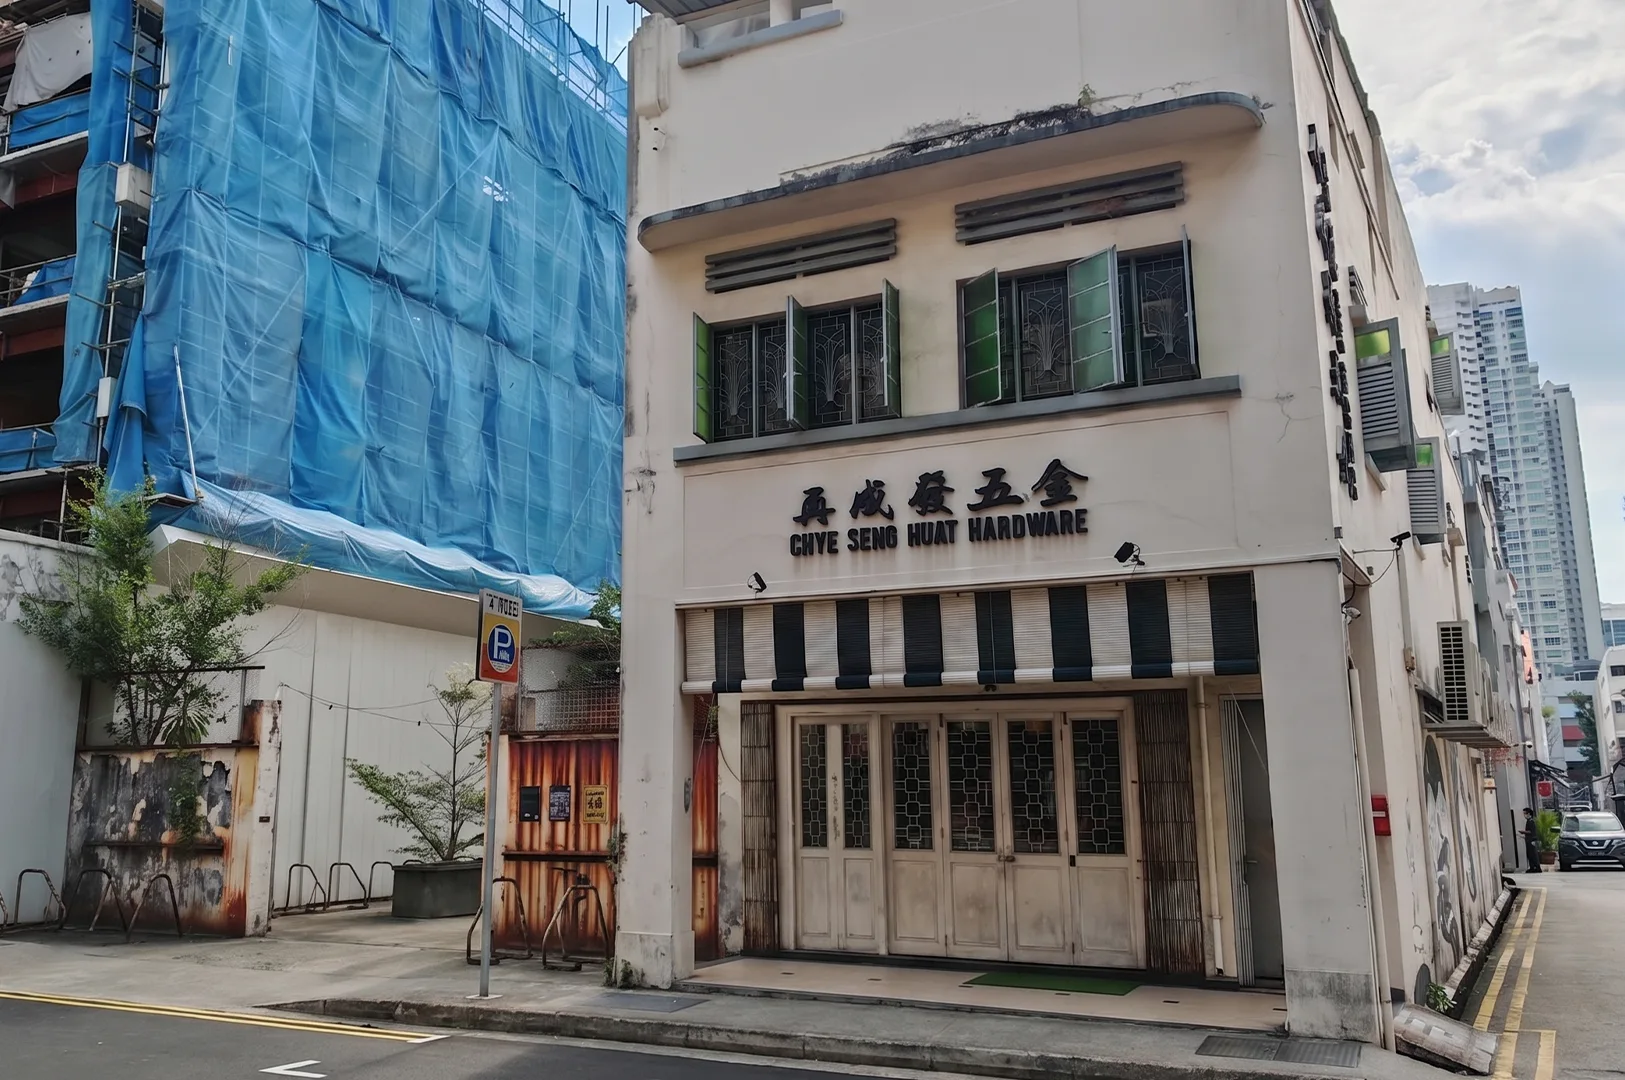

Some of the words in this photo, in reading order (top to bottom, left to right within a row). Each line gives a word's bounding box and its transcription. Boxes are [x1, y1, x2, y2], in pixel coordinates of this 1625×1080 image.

[792, 458, 1089, 526] 再成發五金
[790, 530, 839, 556] CHYE
[847, 525, 898, 551] SENG
[907, 519, 958, 546] HUAT
[968, 508, 1089, 542] HARDWARE
[493, 627, 512, 659] P
